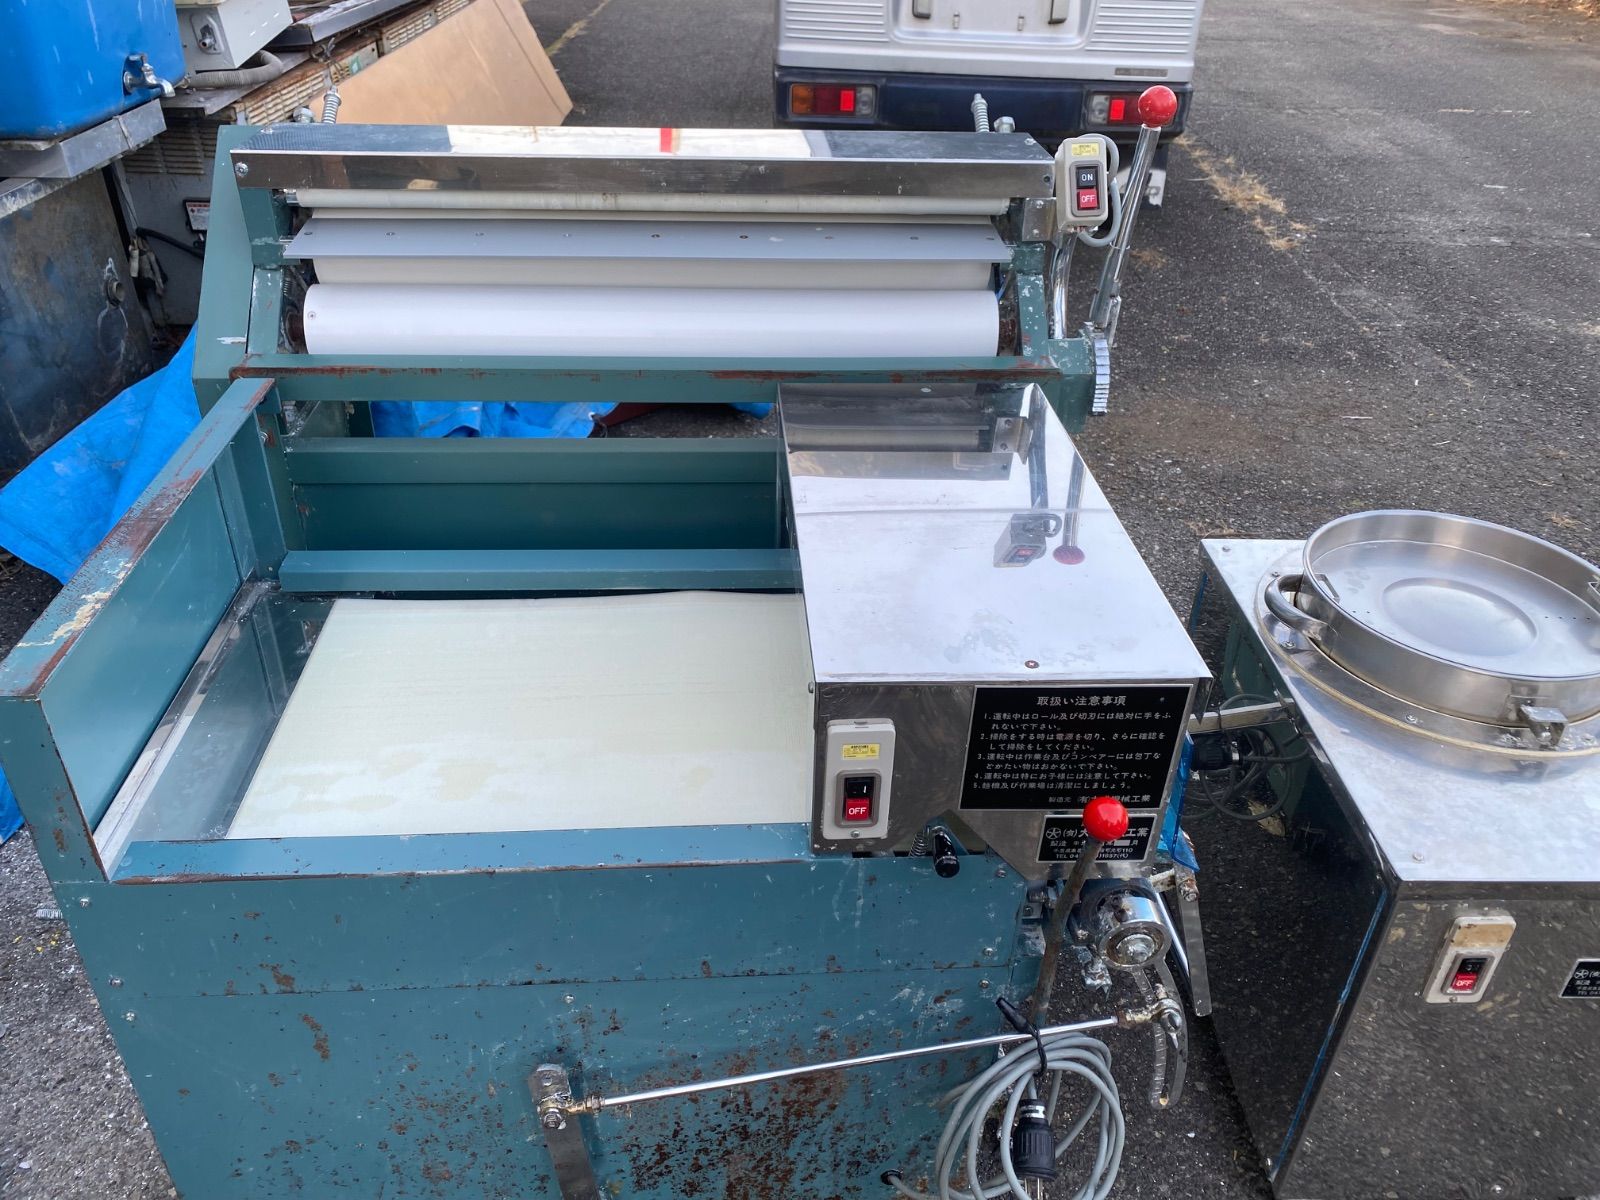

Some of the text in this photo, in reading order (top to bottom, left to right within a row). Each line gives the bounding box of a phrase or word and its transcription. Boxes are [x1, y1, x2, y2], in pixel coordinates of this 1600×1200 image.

[1081, 174, 1093, 182] ON
[1081, 195, 1095, 203] OFF
[1037, 695, 1127, 706] 取扱い注意事項
[848, 807, 867, 815] OFF
[1456, 979, 1472, 987] OFF
